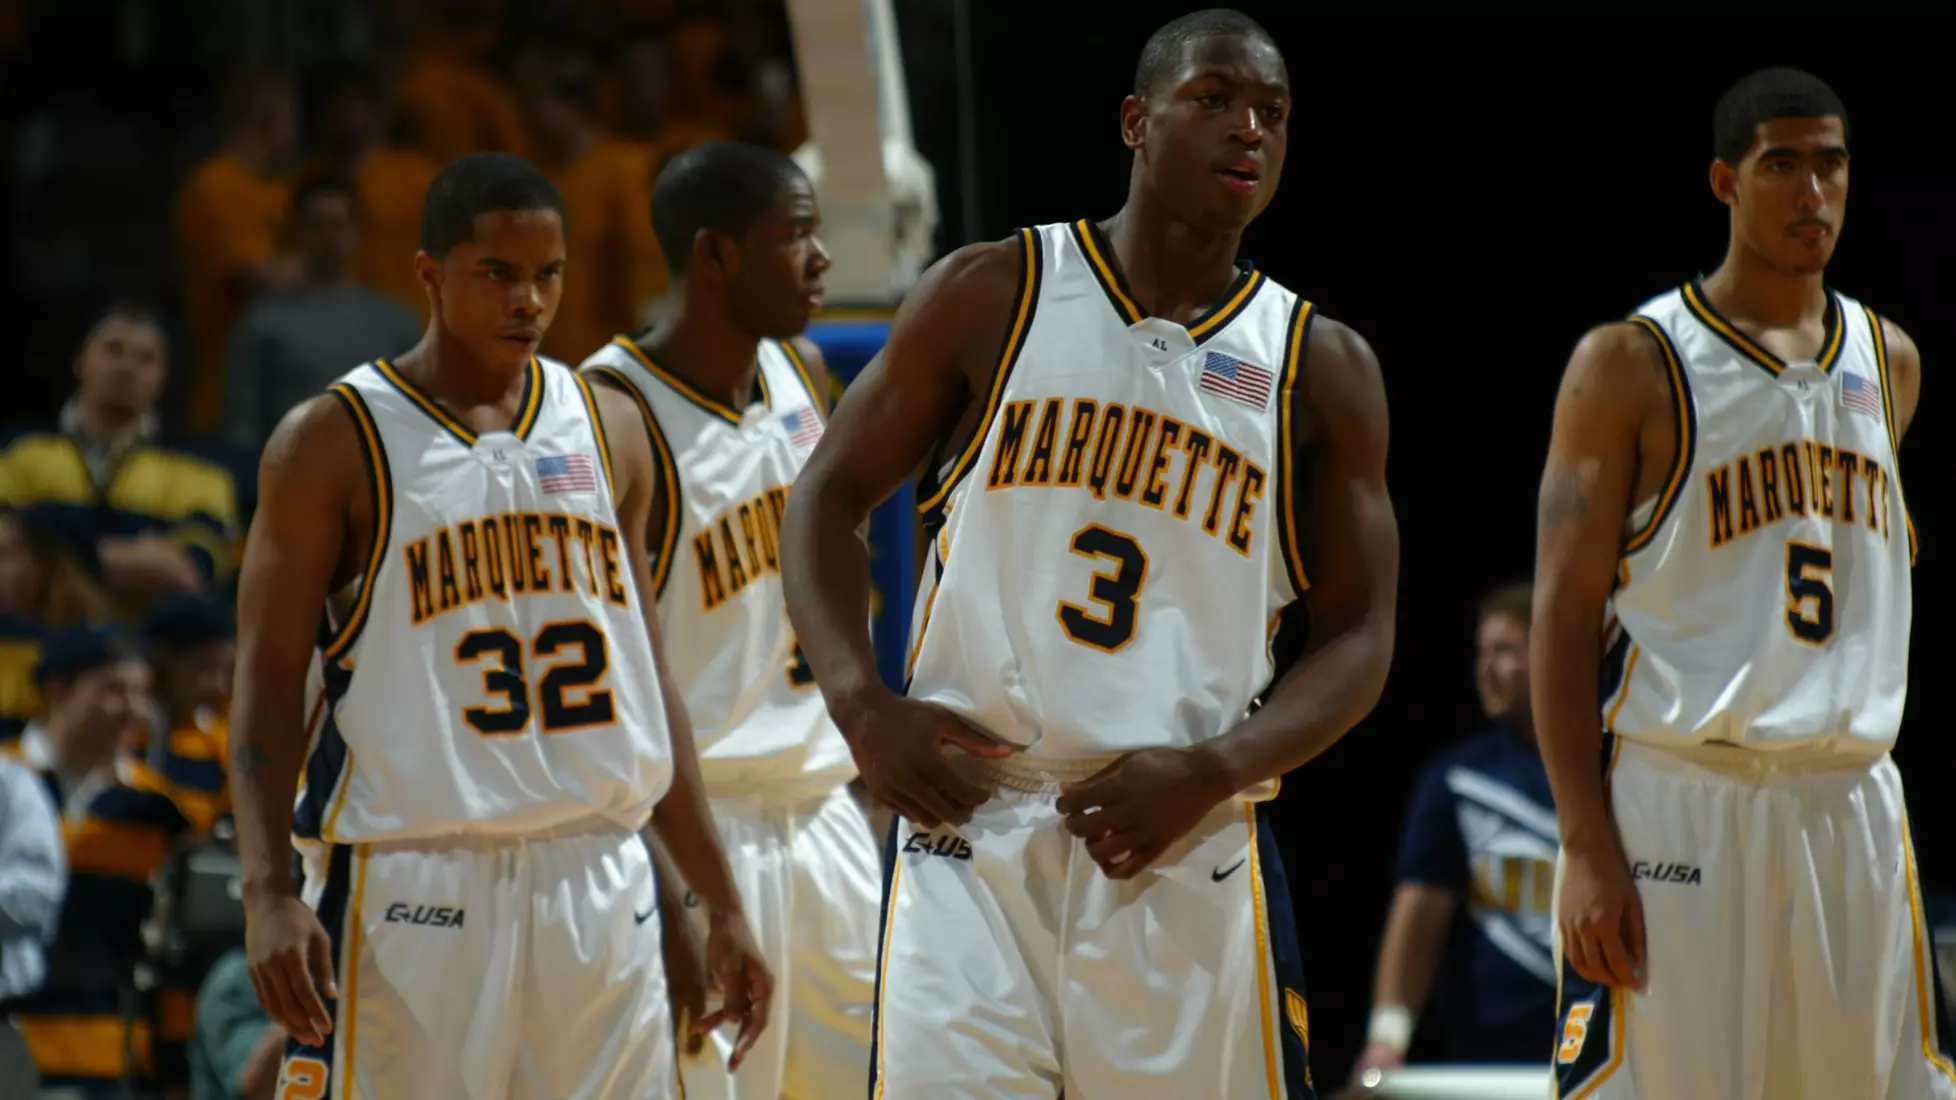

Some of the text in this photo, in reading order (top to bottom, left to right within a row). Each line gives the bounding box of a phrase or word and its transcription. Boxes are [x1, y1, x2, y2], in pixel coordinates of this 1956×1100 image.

[1151, 337, 1168, 352] AL
[984, 397, 1267, 558] MARQUETTE
[403, 511, 629, 626] MARQUETTE
[1055, 522, 1149, 655] 3
[1785, 540, 1834, 647] 5
[453, 617, 617, 737] 32
[1558, 1003, 1595, 1064] 5
